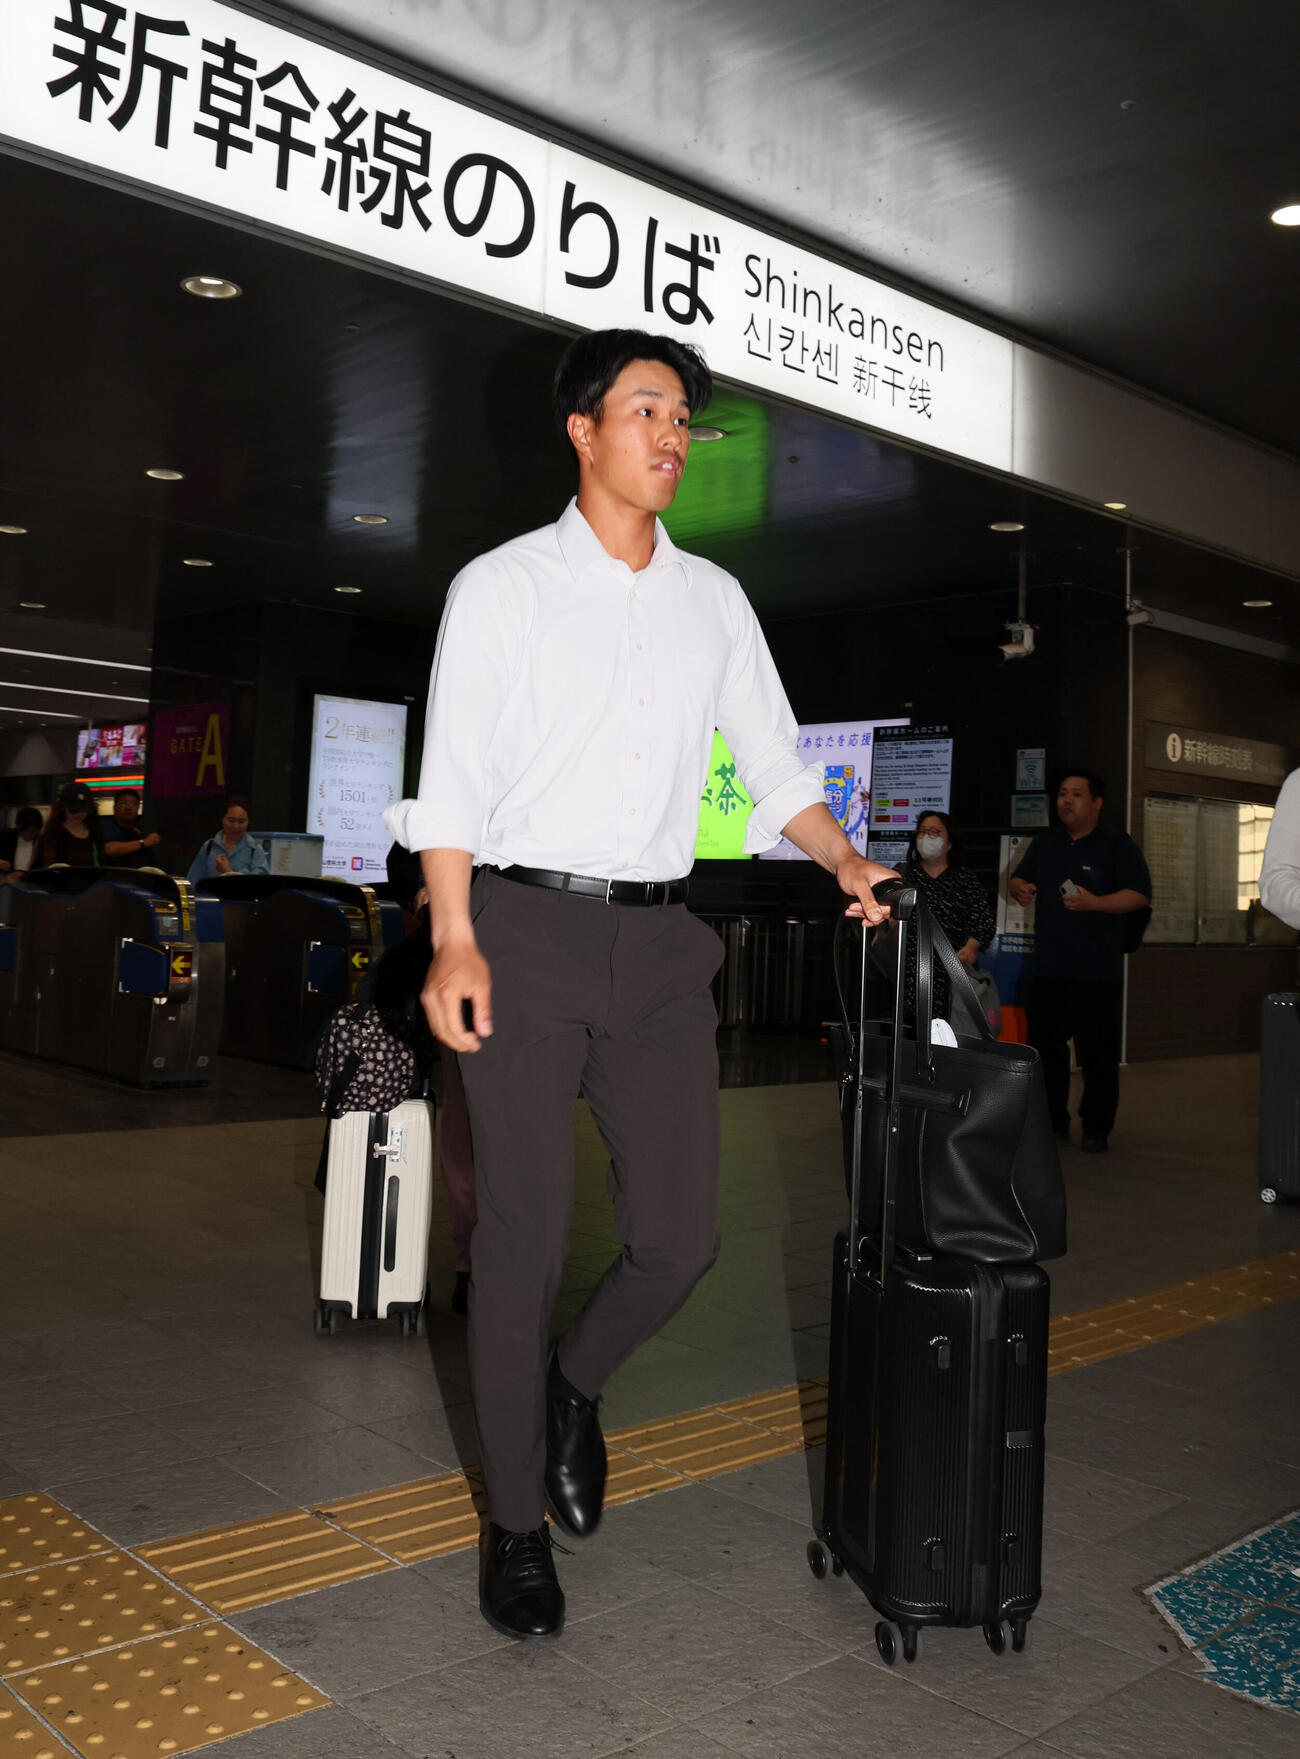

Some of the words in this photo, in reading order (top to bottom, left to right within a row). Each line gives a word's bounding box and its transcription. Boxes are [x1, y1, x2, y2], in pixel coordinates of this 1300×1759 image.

[46, 0, 721, 326] 新幹線のりば
[743, 312, 839, 385] 신칸센
[852, 354, 933, 419] 新干线
[744, 253, 944, 372] Shinkansen
[170, 737, 203, 754] GATE
[195, 713, 225, 787] A
